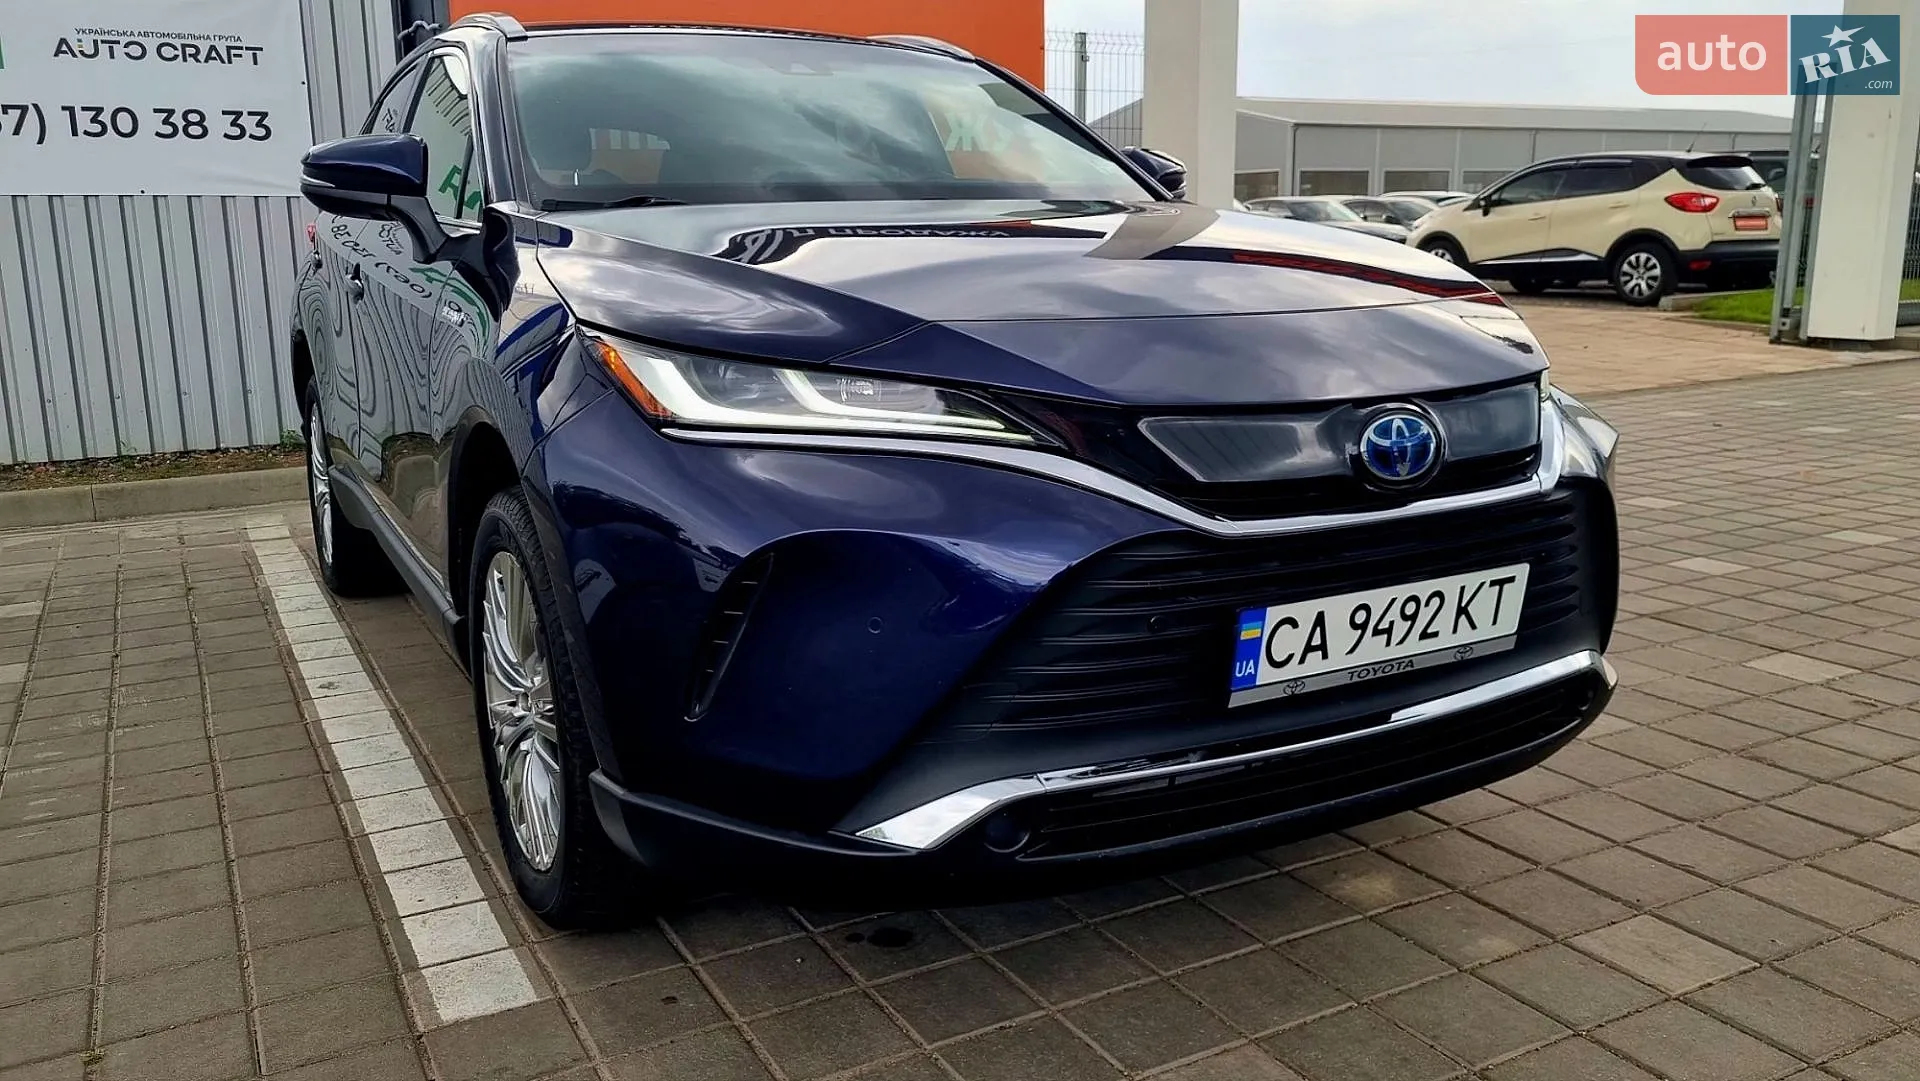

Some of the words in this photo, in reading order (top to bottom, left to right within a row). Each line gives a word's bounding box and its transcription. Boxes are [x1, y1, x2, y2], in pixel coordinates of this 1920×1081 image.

[75, 27, 135, 38] УКРАЇНСЬКА
[137, 31, 211, 43] АВТОМОБІЛЬНА
[213, 35, 242, 44] ГРУПА
[53, 37, 147, 61] AUTO
[157, 42, 263, 66] CRAFT
[0, 102, 47, 145] 7)
[61, 105, 139, 138] 130
[153, 108, 208, 140] 38
[221, 110, 272, 141] 33
[1265, 610, 1329, 669] CA
[1345, 590, 1445, 656] 9492
[1452, 575, 1516, 634] KT
[1235, 659, 1255, 678] UA
[1347, 659, 1415, 681] TOYOTA
